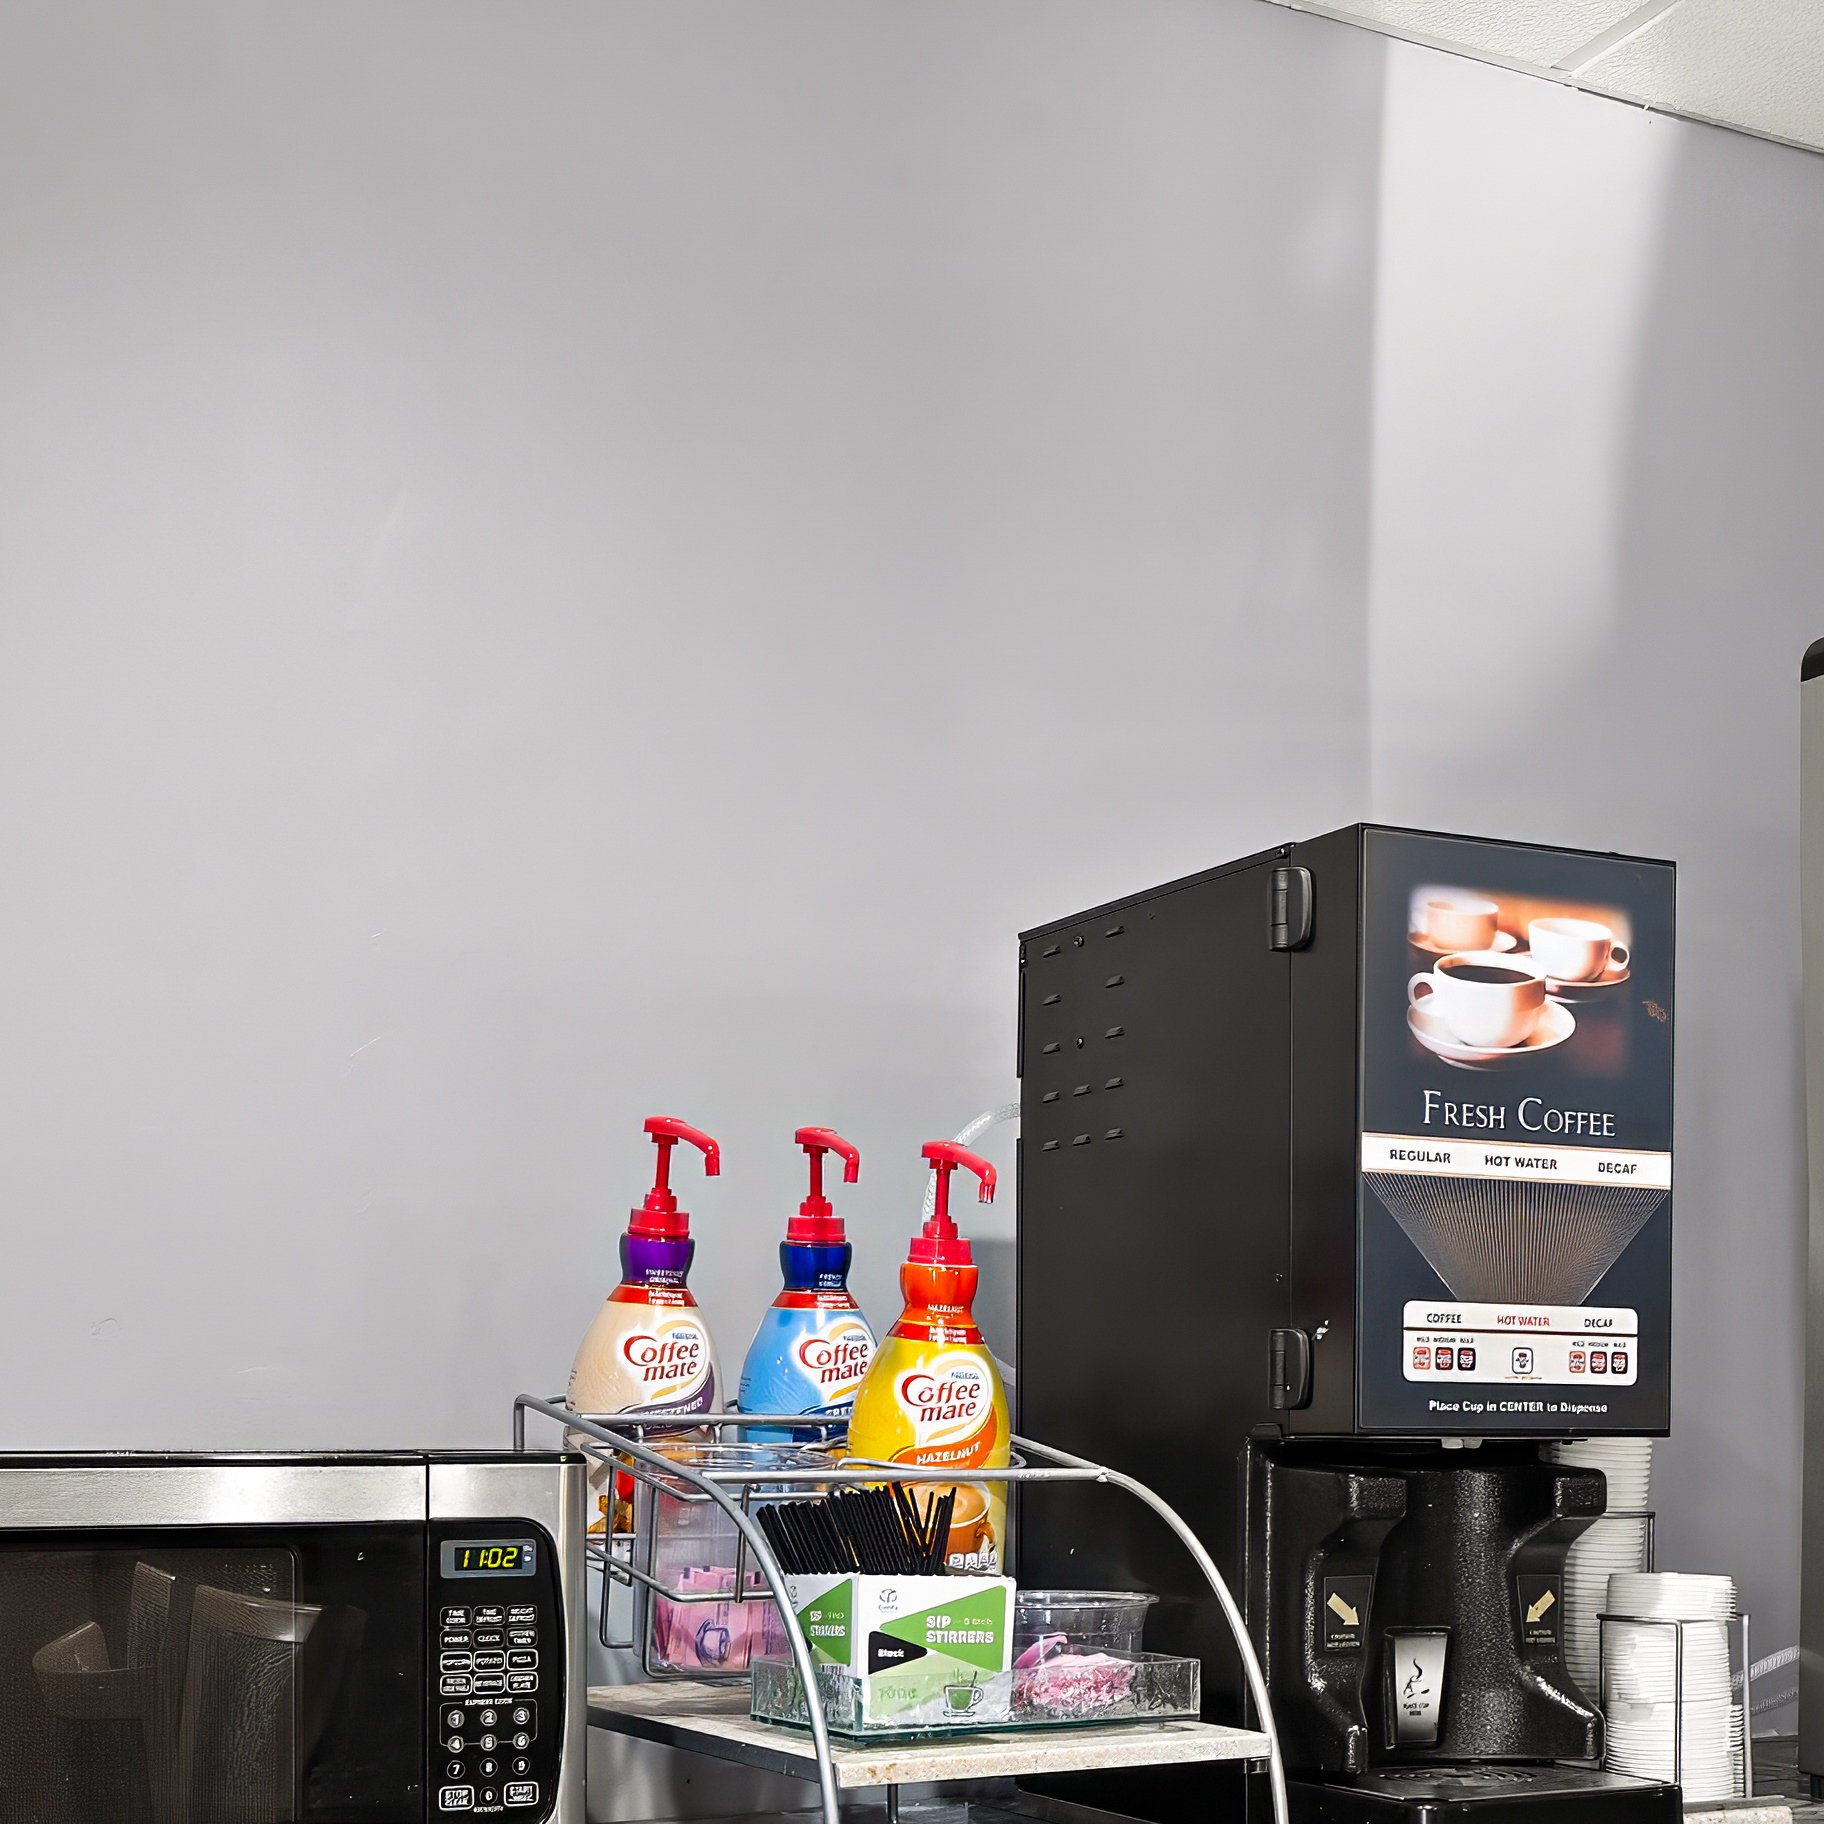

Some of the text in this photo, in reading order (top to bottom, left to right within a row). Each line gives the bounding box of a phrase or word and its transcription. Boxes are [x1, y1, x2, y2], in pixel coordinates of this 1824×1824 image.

[1423, 1089, 1616, 1137] FRESH COFFEE
[1389, 1148, 1451, 1164] REGULAR
[1484, 1154, 1557, 1170] HOT WATER
[1597, 1162, 1637, 1175] DECAF
[1426, 1313, 1462, 1324] COFFEE
[1497, 1314, 1550, 1327] HOT WATER
[623, 1335, 700, 1367] Coffee
[799, 1338, 868, 1369] Coffee
[643, 1361, 697, 1382] mate
[820, 1360, 868, 1384] mate
[901, 1373, 980, 1407] Coffee
[920, 1401, 977, 1422] mate
[1428, 1400, 1608, 1415] Place Cup in CENTER to Dispense
[916, 1441, 981, 1465] HAZELNUT
[463, 1547, 518, 1568] 11:02
[926, 1615, 952, 1629] SIP
[926, 1630, 994, 1644] STIRRERS
[484, 1712, 494, 1723] 2
[452, 1764, 460, 1775] 7
